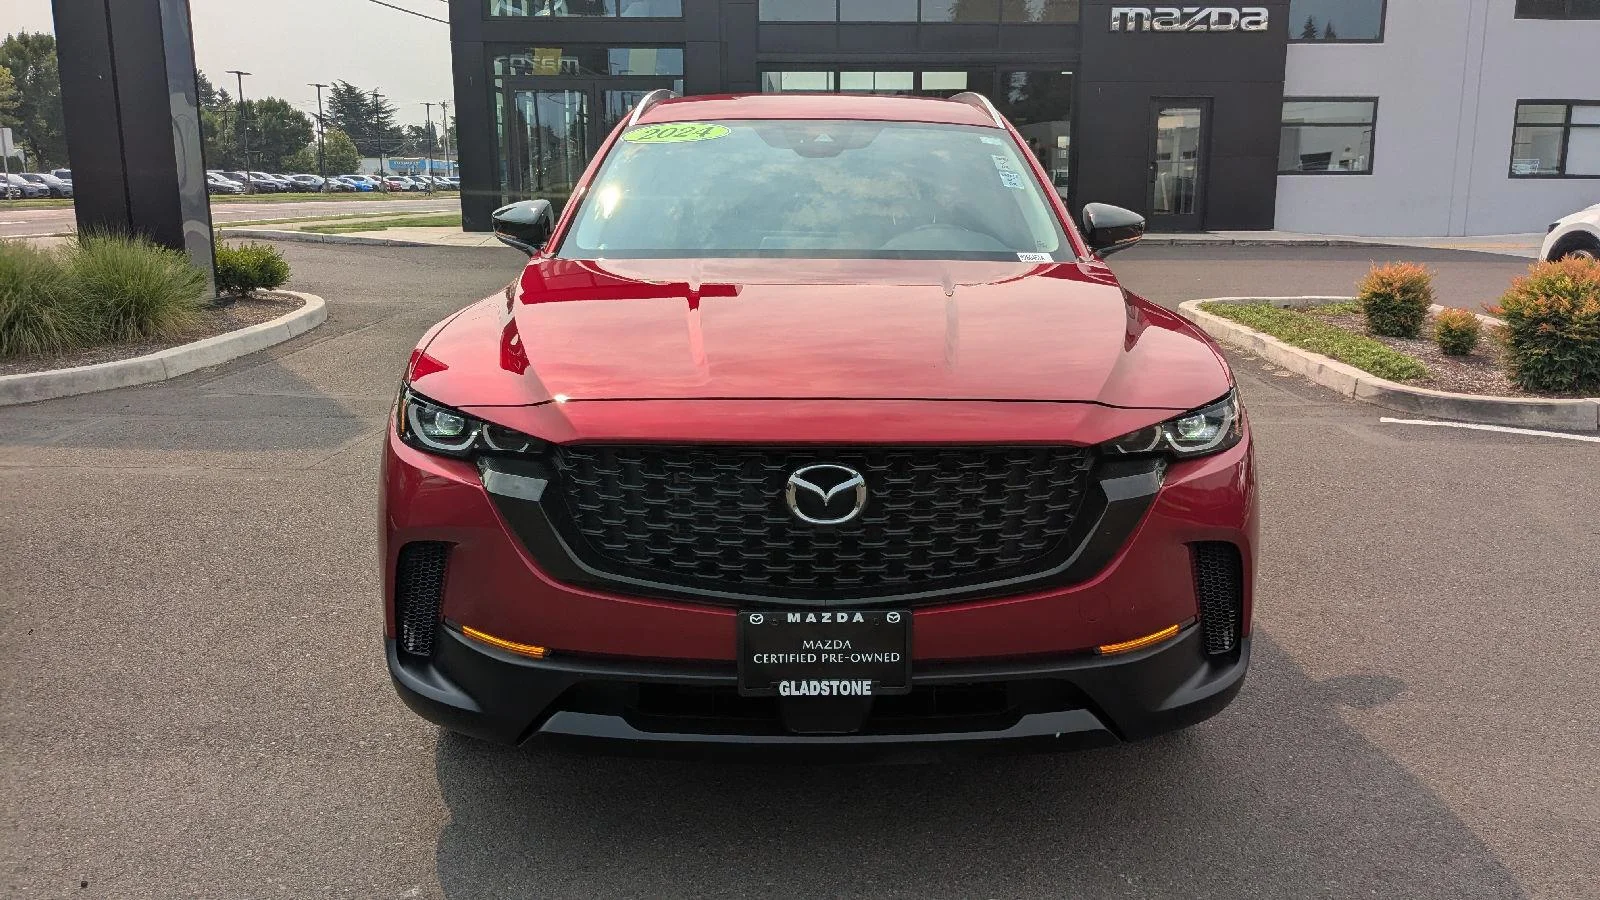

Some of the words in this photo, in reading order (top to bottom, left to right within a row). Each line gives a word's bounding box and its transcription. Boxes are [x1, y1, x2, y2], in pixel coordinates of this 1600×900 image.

[1110, 7, 1269, 32] mazda
[638, 126, 715, 140] 2024
[787, 612, 865, 623] MAZDA
[802, 639, 852, 650] MAZDA
[753, 653, 817, 664] CERTIFIED
[821, 652, 900, 663] PRE-OWNED
[779, 680, 872, 696] GLADSTONE
